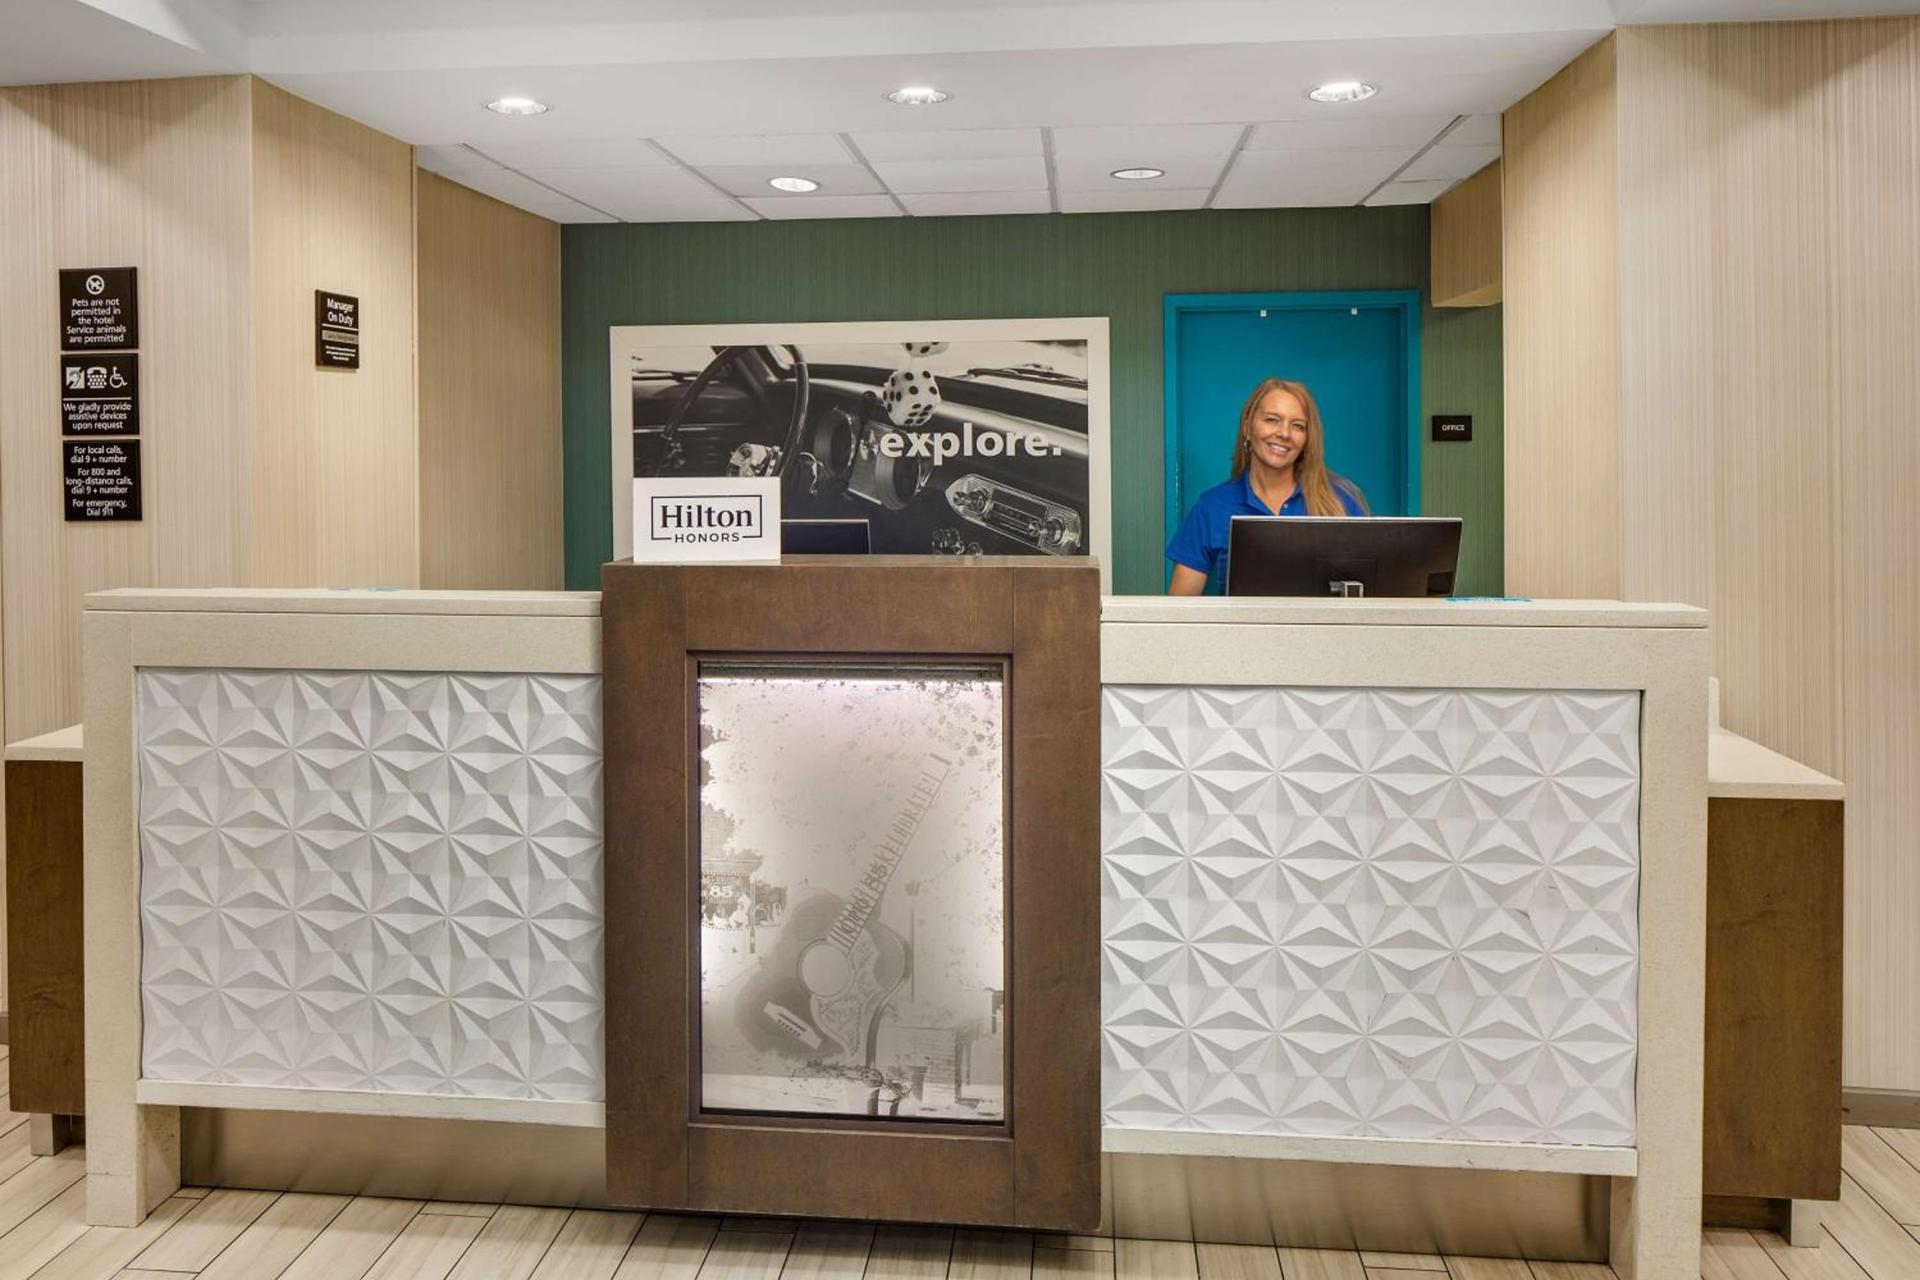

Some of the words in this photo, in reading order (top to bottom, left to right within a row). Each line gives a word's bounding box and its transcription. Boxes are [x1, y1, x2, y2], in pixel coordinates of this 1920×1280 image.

[327, 298, 353, 313] Manager
[71, 308, 111, 317] permitted
[93, 316, 114, 324] hotel
[328, 312, 337, 322] On
[339, 313, 353, 327] Duty
[67, 326, 94, 334] Service
[96, 325, 126, 333] animals
[84, 334, 124, 344] permitted
[63, 403, 76, 411] We
[78, 403, 100, 413] gladly
[103, 402, 131, 413] provide
[94, 422, 123, 430] request
[880, 422, 1063, 466] explore.
[74, 446, 86, 454] For
[88, 446, 104, 454] local
[106, 445, 123, 454] calls,
[66, 477, 114, 486] long-distance
[116, 476, 133, 486] calls,
[71, 486, 84, 494] dial
[86, 486, 91, 494] 9
[100, 486, 128, 494] number
[73, 499, 84, 507] For
[102, 508, 113, 516] 911
[661, 505, 752, 528] Hilton
[675, 532, 740, 543] HONORS
[710, 885, 733, 898] 85
